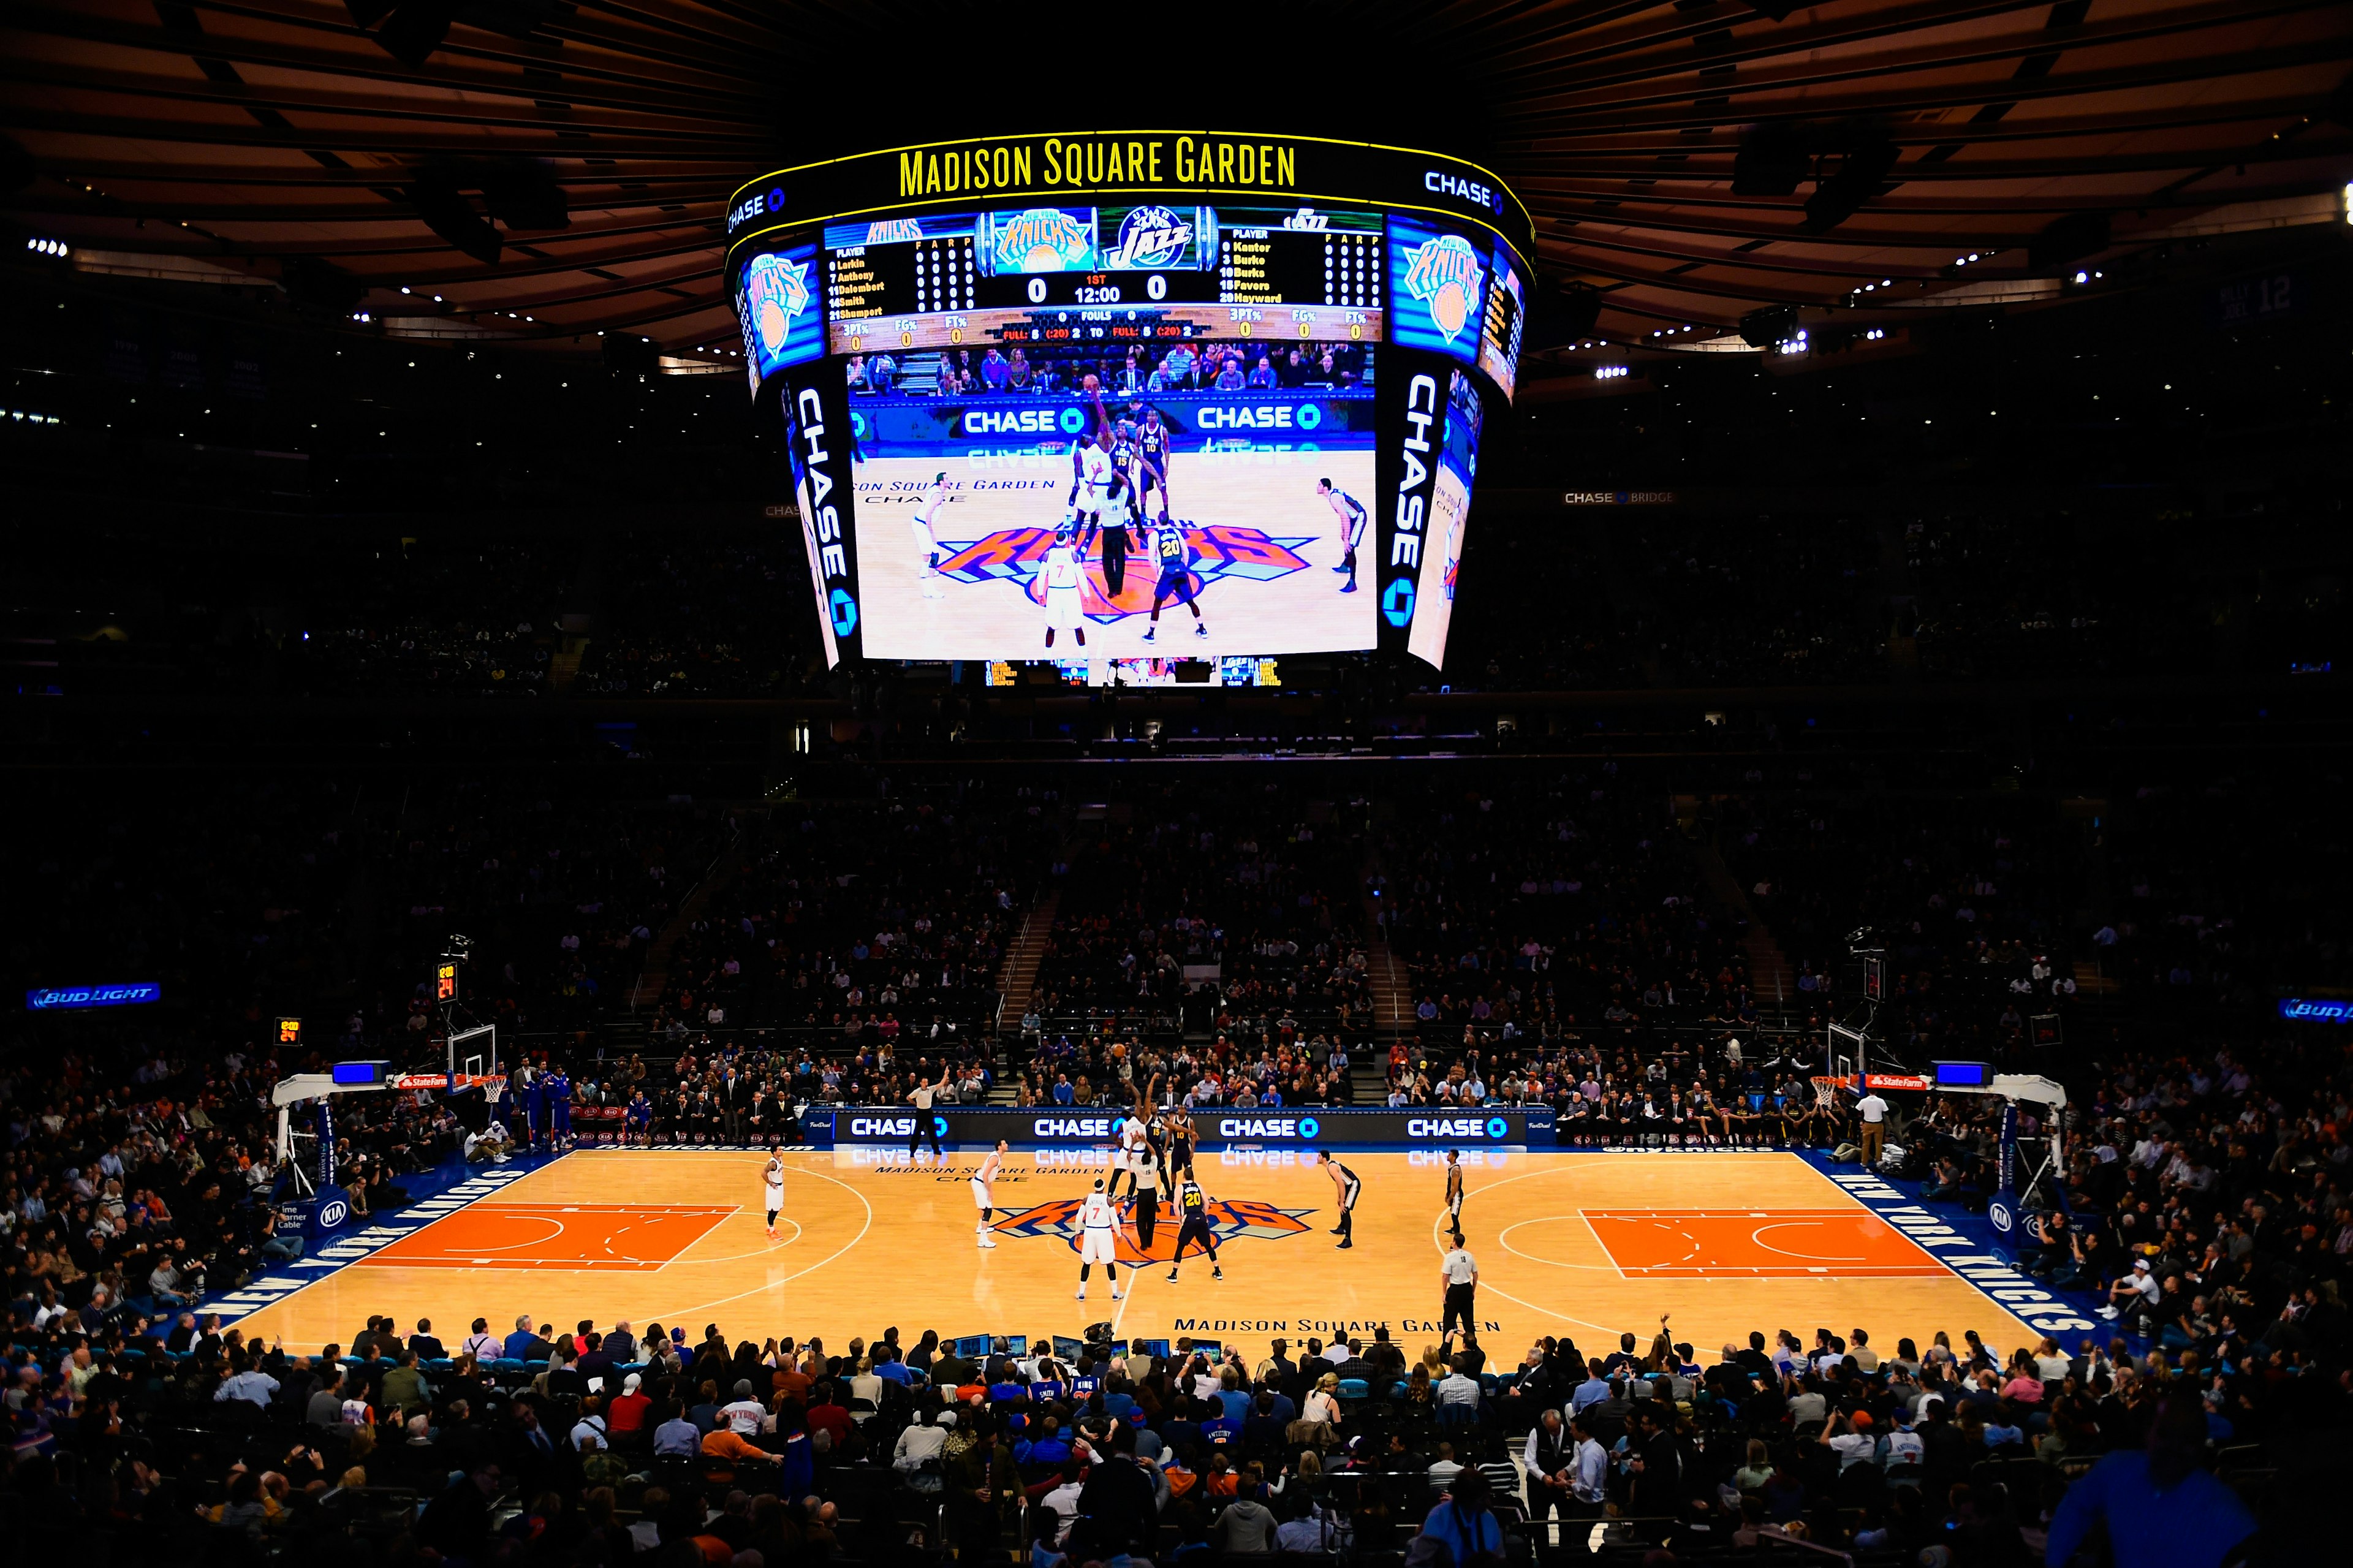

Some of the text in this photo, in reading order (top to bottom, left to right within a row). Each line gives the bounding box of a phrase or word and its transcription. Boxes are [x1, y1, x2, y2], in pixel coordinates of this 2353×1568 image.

[900, 136, 1295, 197] MADISON SQUARE GARDEN
[1425, 171, 1491, 208] CHASE
[728, 195, 763, 234] CHASE
[1133, 207, 1170, 220] UTAH
[866, 218, 923, 244] KNICKS
[1001, 218, 1083, 254] KNICKS
[1233, 229, 1378, 245] PLAYER F A R P
[836, 246, 865, 258] PLAYER
[915, 241, 922, 250] F
[932, 240, 938, 248] A
[948, 238, 954, 247] R
[1109, 225, 1190, 269] JAZZ
[1222, 241, 1230, 252] 0
[829, 259, 865, 271] 0 Larkin
[1222, 254, 1265, 265] 3 Burke
[830, 271, 874, 284] 7 Anthony
[1086, 275, 1107, 285] 1ST
[1219, 267, 1233, 278] 10
[828, 286, 839, 296] 11
[1028, 278, 1047, 303] 0
[1147, 275, 1167, 300] 0
[1220, 280, 1270, 290] 15 Favors
[829, 296, 865, 308] 14 Smith
[1075, 287, 1120, 303] 12:00
[1220, 293, 1282, 304] 20 Hayward
[2260, 275, 2290, 313] 12
[829, 311, 840, 320] 21
[895, 319, 917, 331] FG%
[945, 316, 967, 328] FT%
[1058, 311, 1135, 322] 0 FOULS 0
[1292, 309, 1316, 322] FG%
[1345, 311, 1366, 324] FT%
[1004, 331, 1028, 340] FULL:
[1046, 329, 1069, 339] (:20)
[1072, 329, 1080, 339] 2
[1091, 328, 1104, 338] TO
[1113, 327, 1138, 336] FULL:
[1157, 327, 1180, 336] (:20)
[1183, 327, 1191, 337] 2
[1239, 321, 1362, 339] 0 0 0
[851, 328, 962, 351] 0 0 0
[964, 410, 1056, 433] CHASE
[1197, 407, 1292, 428] CHASE
[1117, 456, 1127, 466] 15
[1392, 374, 1436, 569] CHASE
[799, 388, 847, 580] CHASE
[974, 480, 1055, 490] GARDEN
[865, 495, 967, 504] CHAE
[1565, 492, 1673, 504] CHASE BRIDGE
[765, 507, 800, 515] CHAS
[1162, 540, 1180, 558] 20
[1056, 565, 1064, 578] 7
[44, 988, 152, 1004] BUD LIGHT
[439, 979, 453, 999] 24
[2295, 1004, 2343, 1017] BUD
[281, 1031, 295, 1042] 24
[852, 1118, 925, 1135] CHAS
[1035, 1118, 1109, 1137] CHASE
[1220, 1119, 1296, 1137] CHASE
[1408, 1119, 1483, 1137] CHASE
[1185, 1192, 1201, 1206] 20
[325, 1206, 343, 1224] KIA
[1093, 1207, 1100, 1219] 7
[1994, 1211, 2008, 1229] KIA
[194, 1170, 525, 1316] NEW YORK KNICKS
[1830, 1174, 2096, 1331] NEW YORK KNICKS
[1174, 1319, 1286, 1331] MADISON
[1297, 1319, 1392, 1333] SQUARE
[1078, 1381, 1093, 1390] KING
